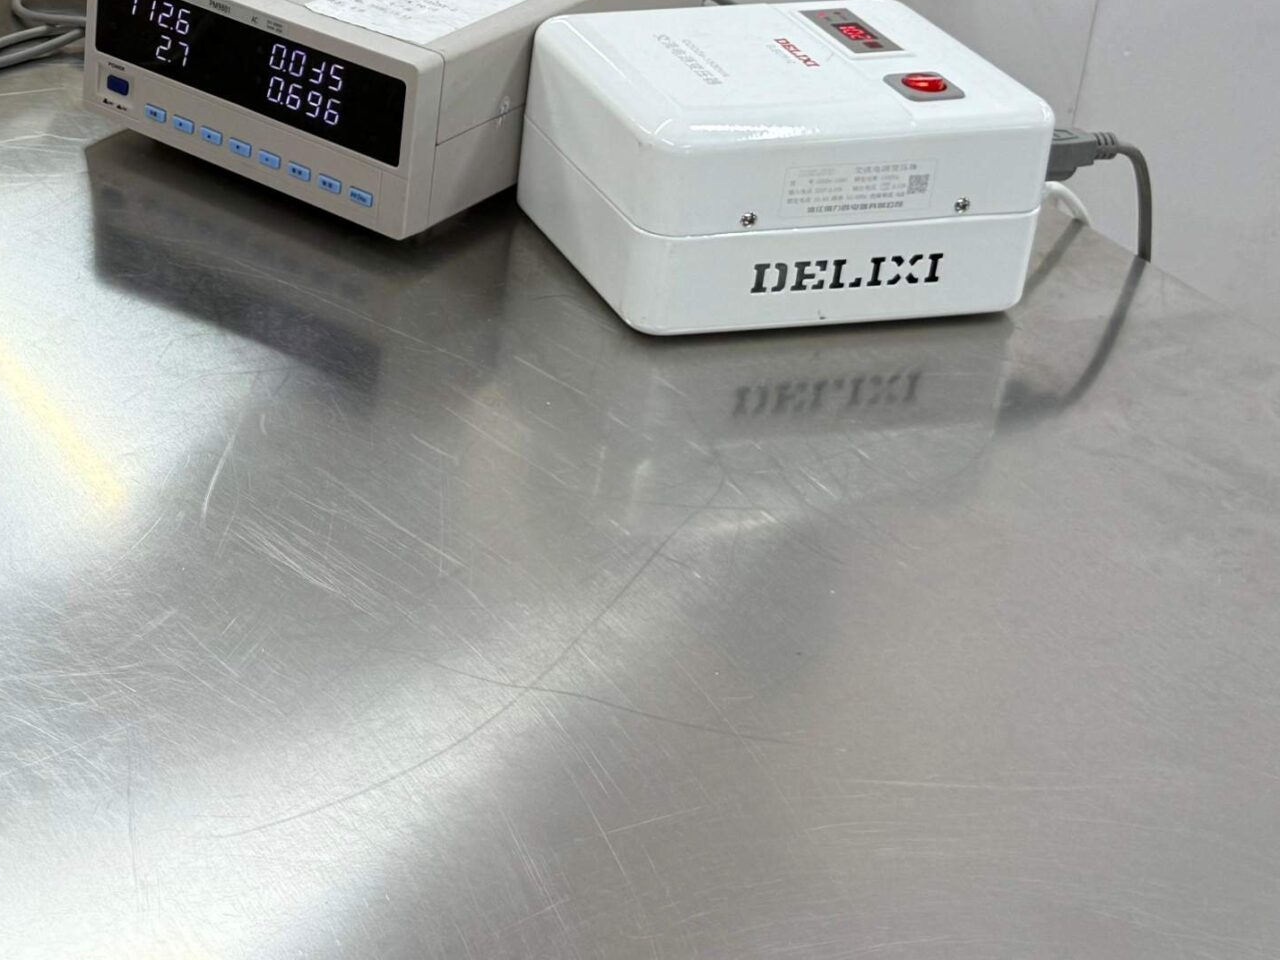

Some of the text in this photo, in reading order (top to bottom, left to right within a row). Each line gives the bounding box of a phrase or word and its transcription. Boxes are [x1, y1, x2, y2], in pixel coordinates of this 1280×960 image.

[155, 35, 190, 68] 2.7
[773, 38, 821, 67] DELIXI
[267, 76, 341, 125] 0.696
[750, 253, 944, 294] DELIXI
